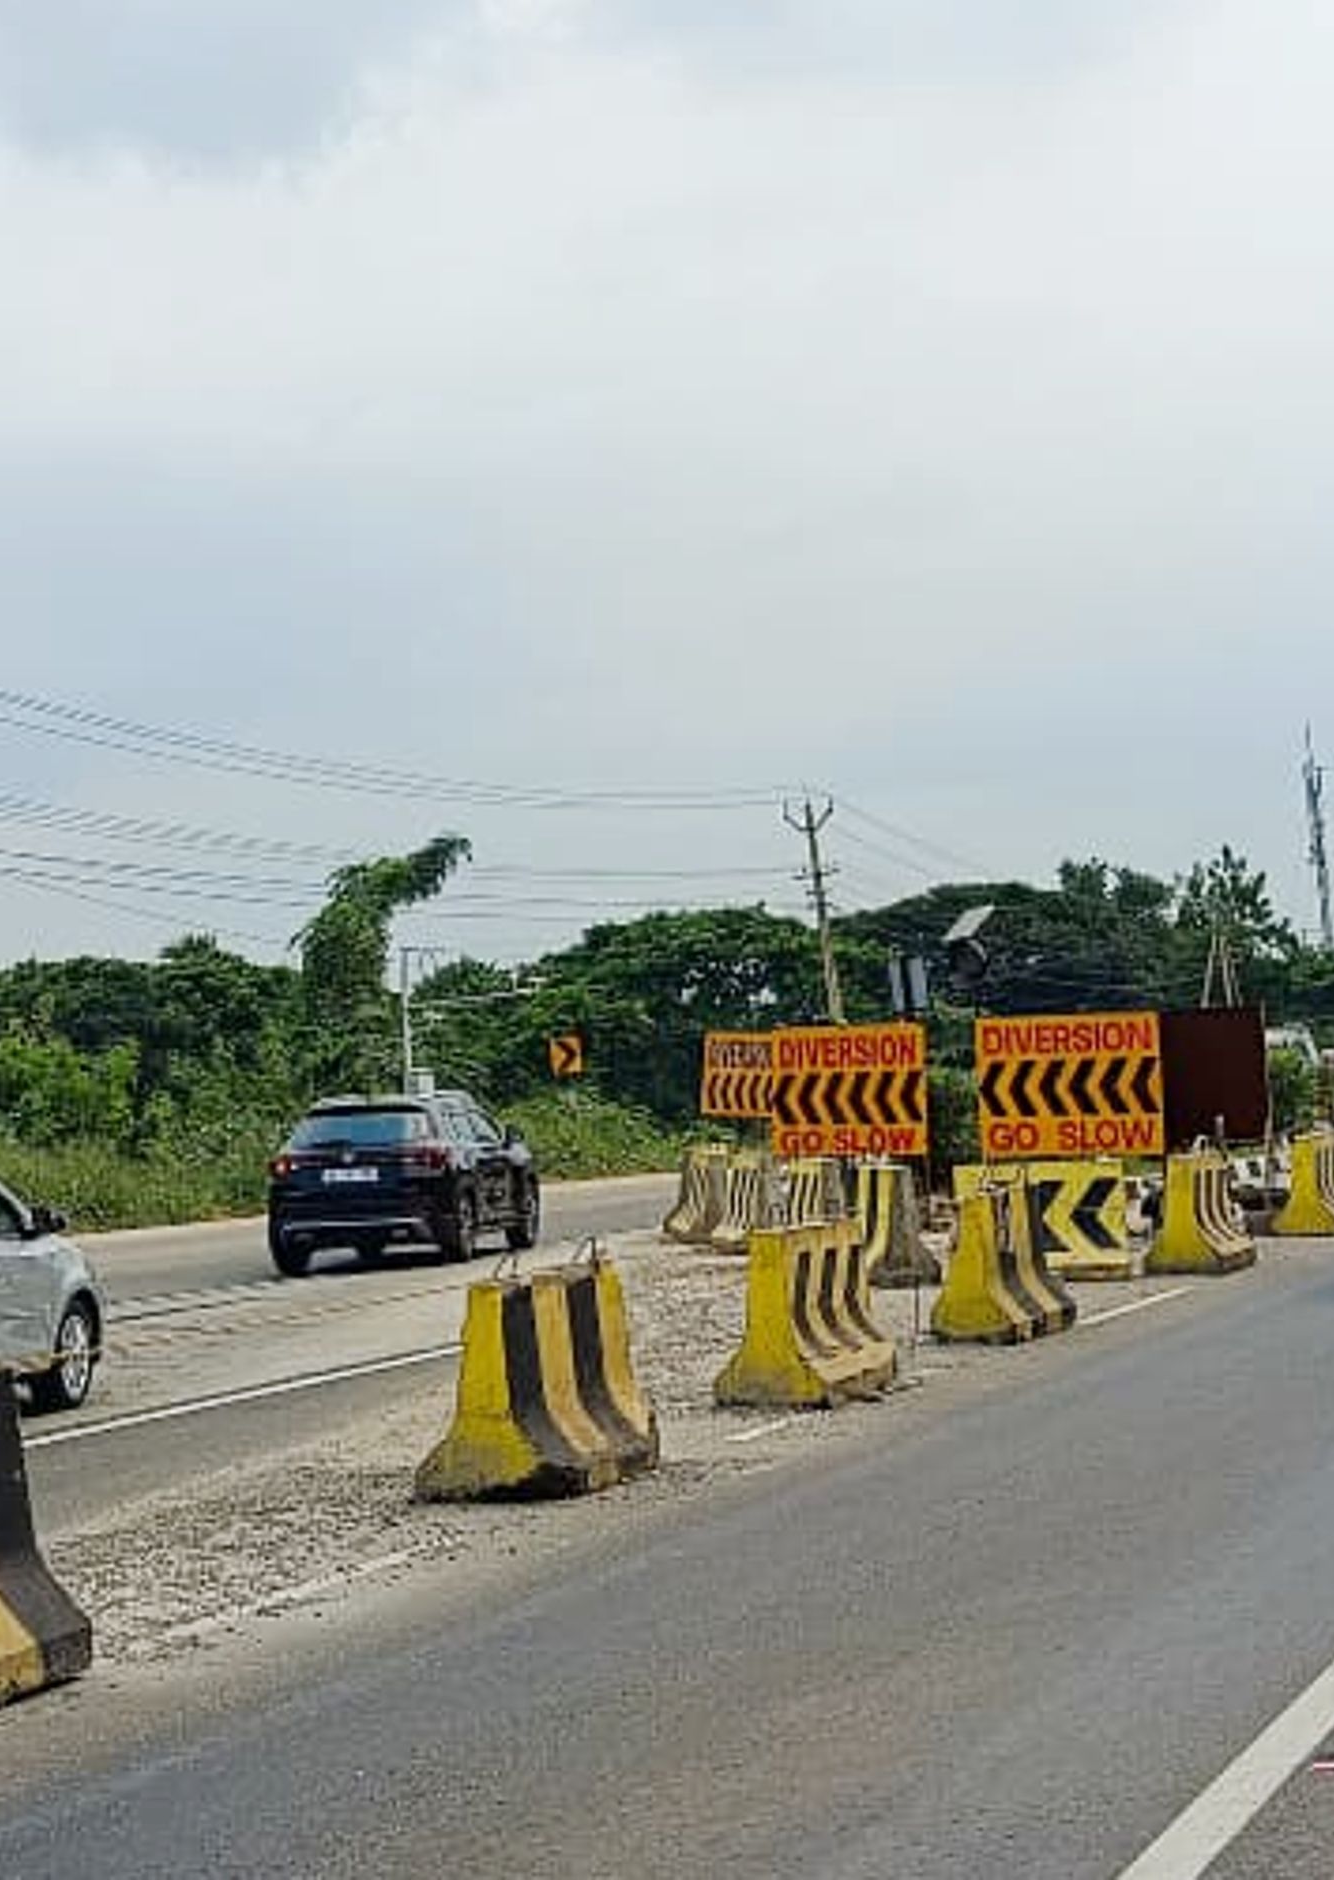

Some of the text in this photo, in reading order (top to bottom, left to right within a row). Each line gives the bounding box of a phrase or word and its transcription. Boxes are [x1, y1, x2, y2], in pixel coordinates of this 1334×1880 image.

[778, 1034, 916, 1068] DIVERSION
[982, 1019, 1150, 1055] DIVERSION
[781, 1127, 915, 1156] GO SLOW
[989, 1120, 1155, 1151] GO SLOW
